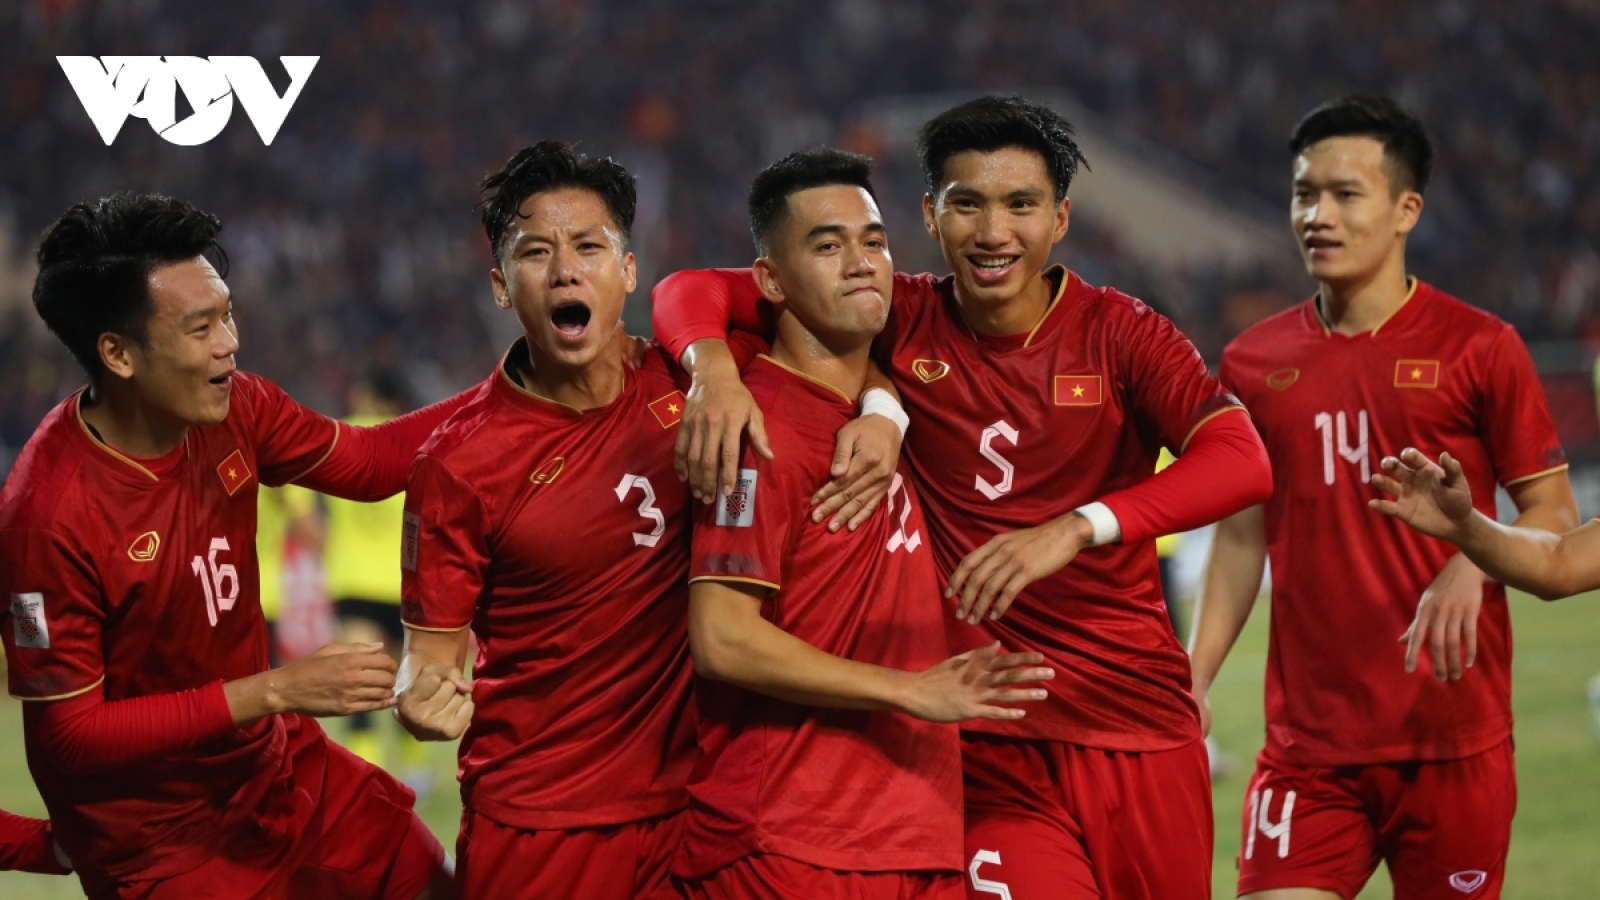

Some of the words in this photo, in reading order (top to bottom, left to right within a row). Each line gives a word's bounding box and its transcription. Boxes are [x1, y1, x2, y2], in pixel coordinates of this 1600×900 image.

[974, 420, 1019, 500] 5
[1314, 410, 1370, 485] 14
[614, 474, 665, 548] 3
[191, 536, 240, 627] 16
[1244, 788, 1297, 860] 14
